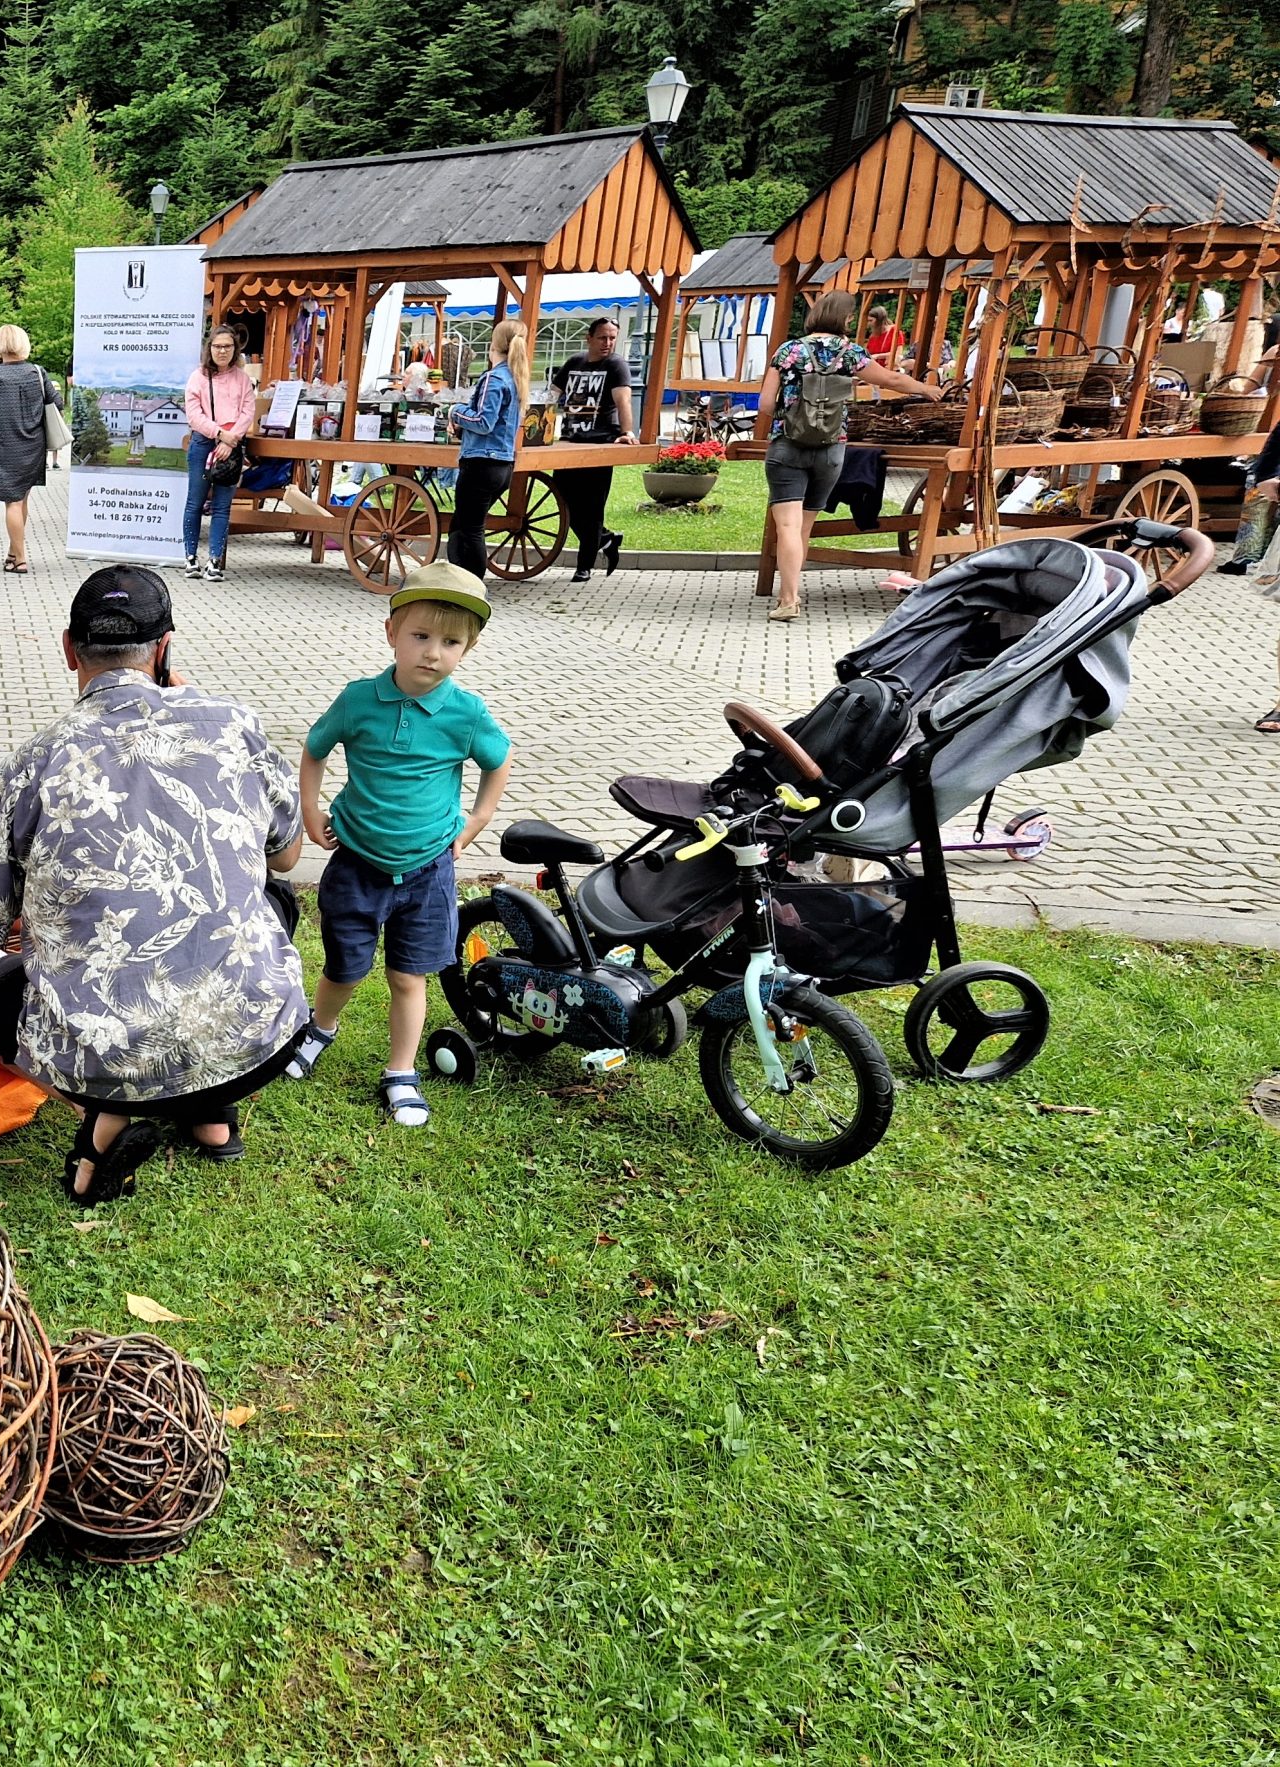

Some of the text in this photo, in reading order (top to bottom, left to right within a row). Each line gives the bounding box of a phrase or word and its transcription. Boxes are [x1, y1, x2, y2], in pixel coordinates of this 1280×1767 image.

[102, 344, 119, 352] KRS
[566, 375, 603, 394] NEW
[87, 487, 98, 495] ul.
[154, 490, 170, 498] 42b
[88, 499, 117, 508] 34-700
[118, 501, 145, 510] Rabka
[110, 513, 120, 521] 18
[121, 514, 132, 522] 26
[134, 515, 145, 523] 77
[146, 516, 162, 524] 972
